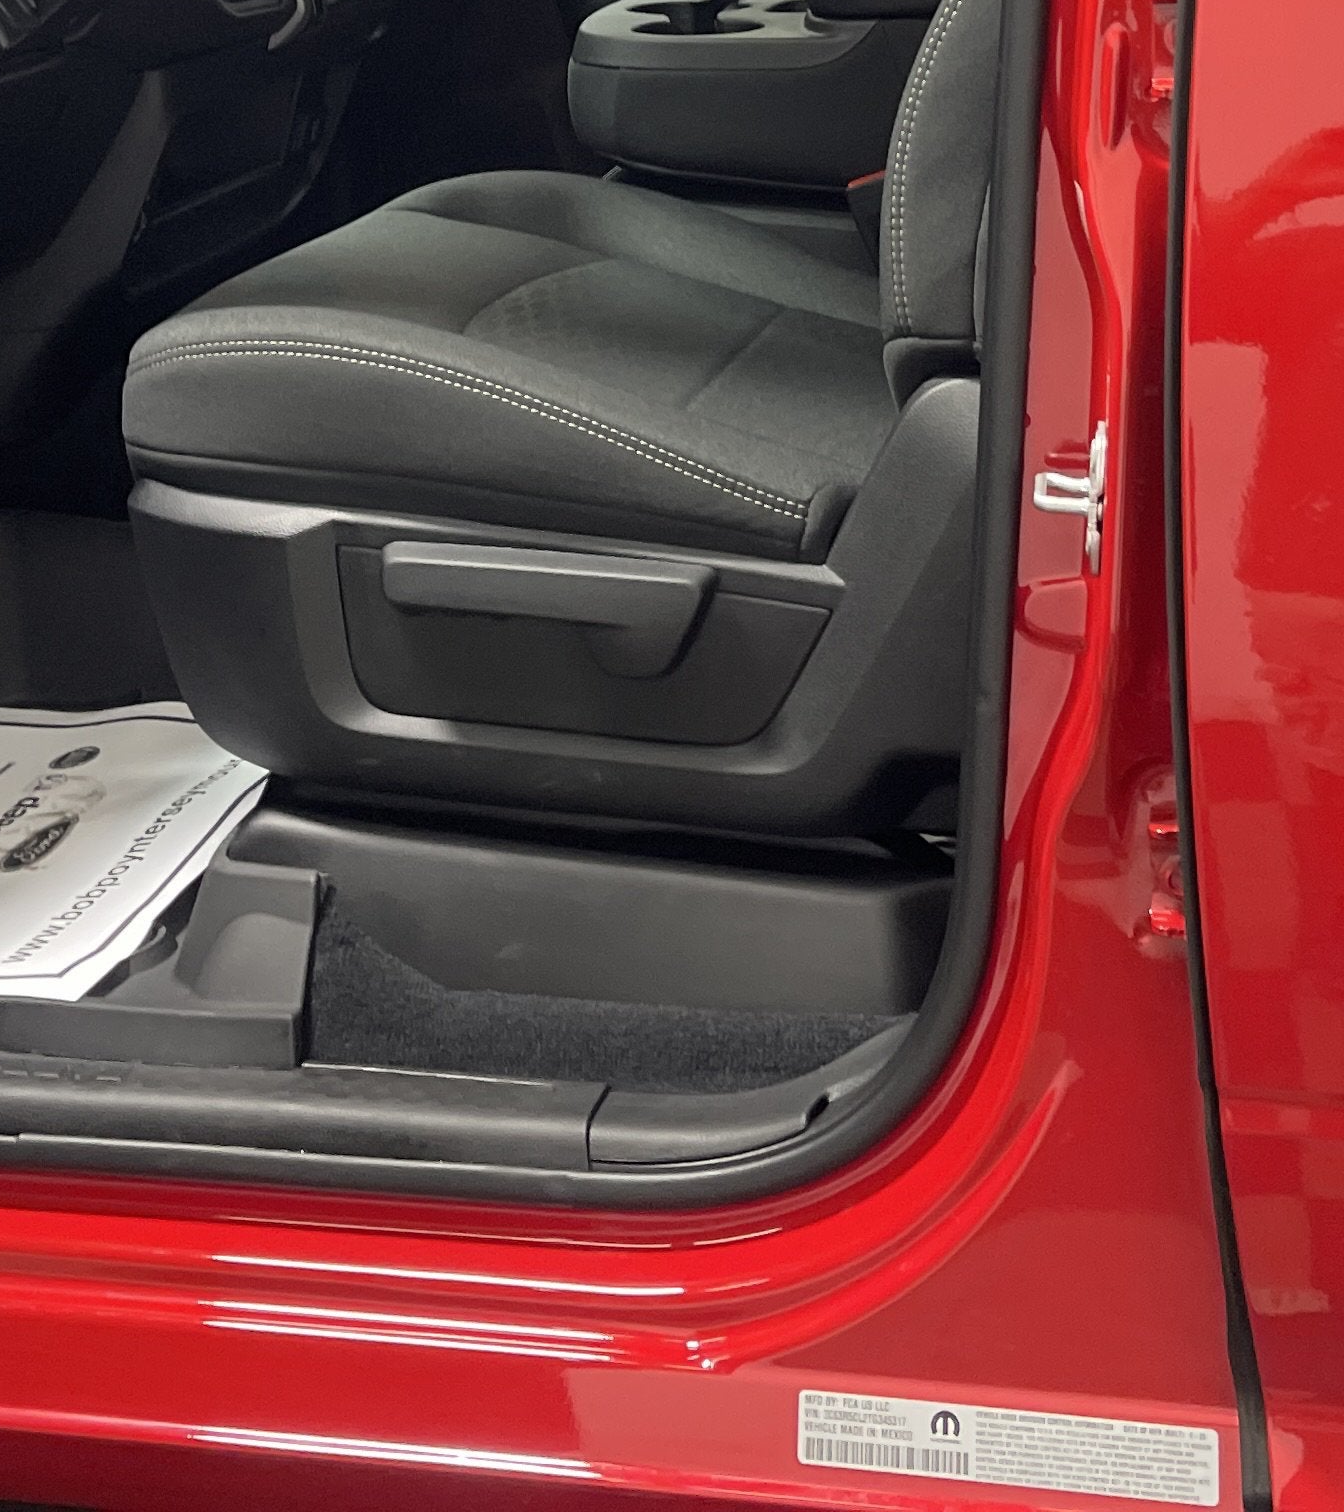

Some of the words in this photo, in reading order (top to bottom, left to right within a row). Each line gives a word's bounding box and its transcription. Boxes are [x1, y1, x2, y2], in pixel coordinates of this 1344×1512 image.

[861, 1399, 873, 1411] US
[875, 1400, 890, 1412] LLC
[804, 1420, 837, 1434] VEHICLE
[840, 1424, 864, 1437] MADE
[881, 1428, 913, 1442] MEXICO
